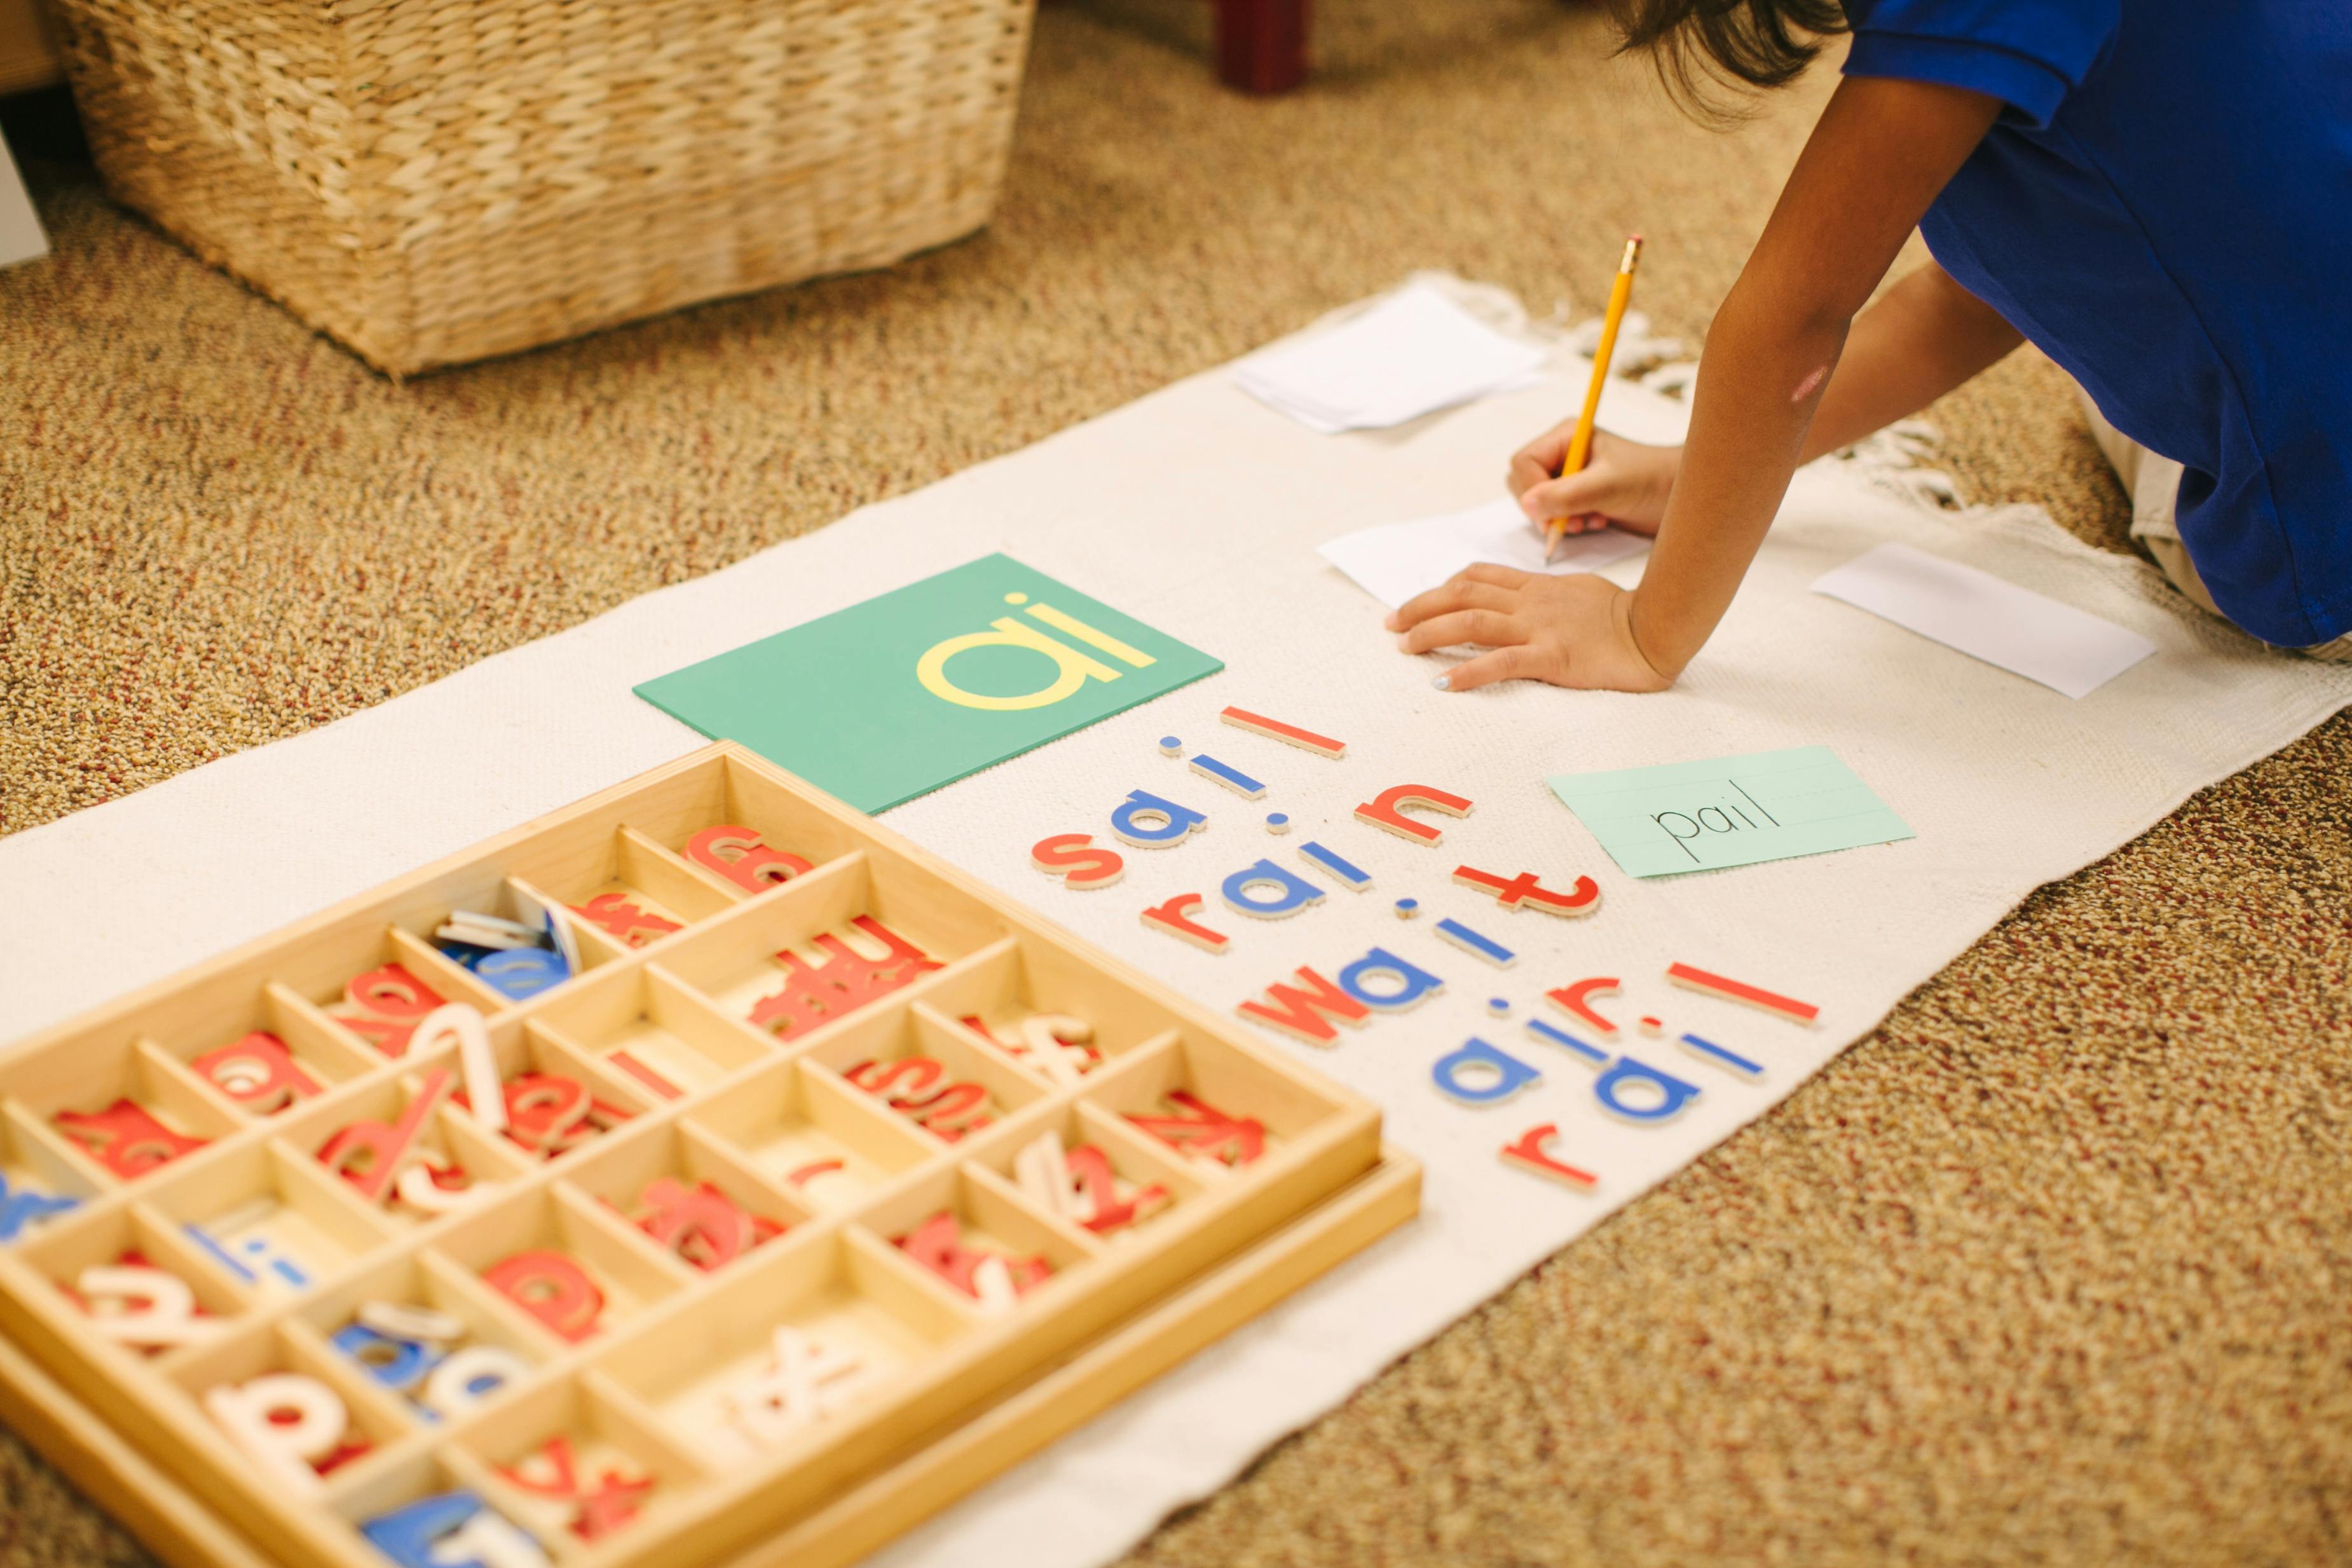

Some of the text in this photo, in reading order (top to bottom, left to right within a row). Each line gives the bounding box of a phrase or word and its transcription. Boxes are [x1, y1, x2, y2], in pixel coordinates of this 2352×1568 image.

[916, 592, 1158, 711] ai
[1031, 706, 1346, 889] sail
[1140, 784, 1474, 953] rain
[1650, 779, 1781, 863] pail
[1237, 865, 1601, 1047] wait
[1431, 977, 1622, 1107] air
[1499, 962, 1820, 1192] rail
